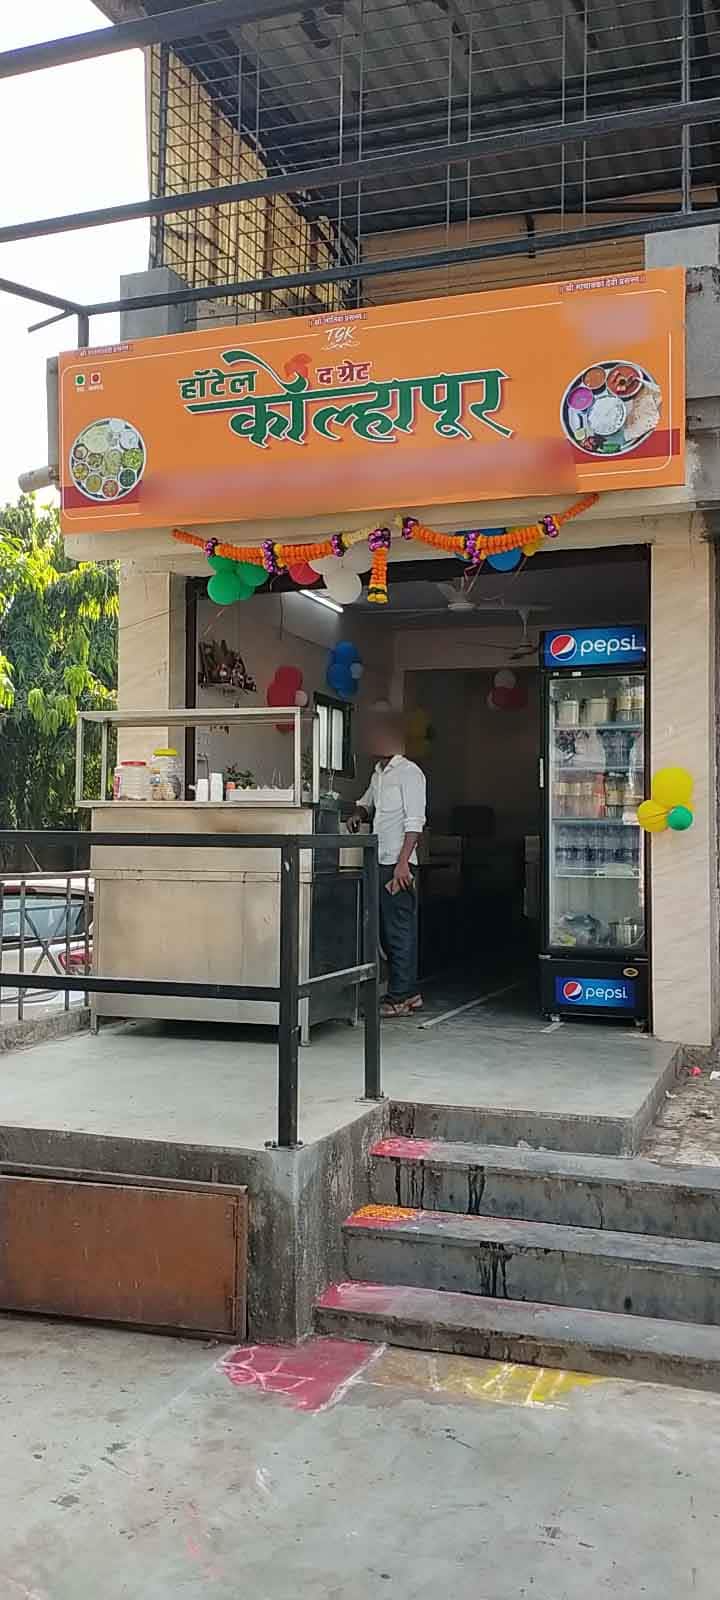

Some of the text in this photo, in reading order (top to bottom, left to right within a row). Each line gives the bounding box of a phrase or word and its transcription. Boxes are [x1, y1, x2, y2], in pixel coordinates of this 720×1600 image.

[325, 326, 357, 342] TGK
[178, 368, 259, 399] हॉटेल
[316, 360, 373, 385] द ग्रेट
[581, 634, 637, 657] pepsi
[585, 986, 626, 1001] pepsi
